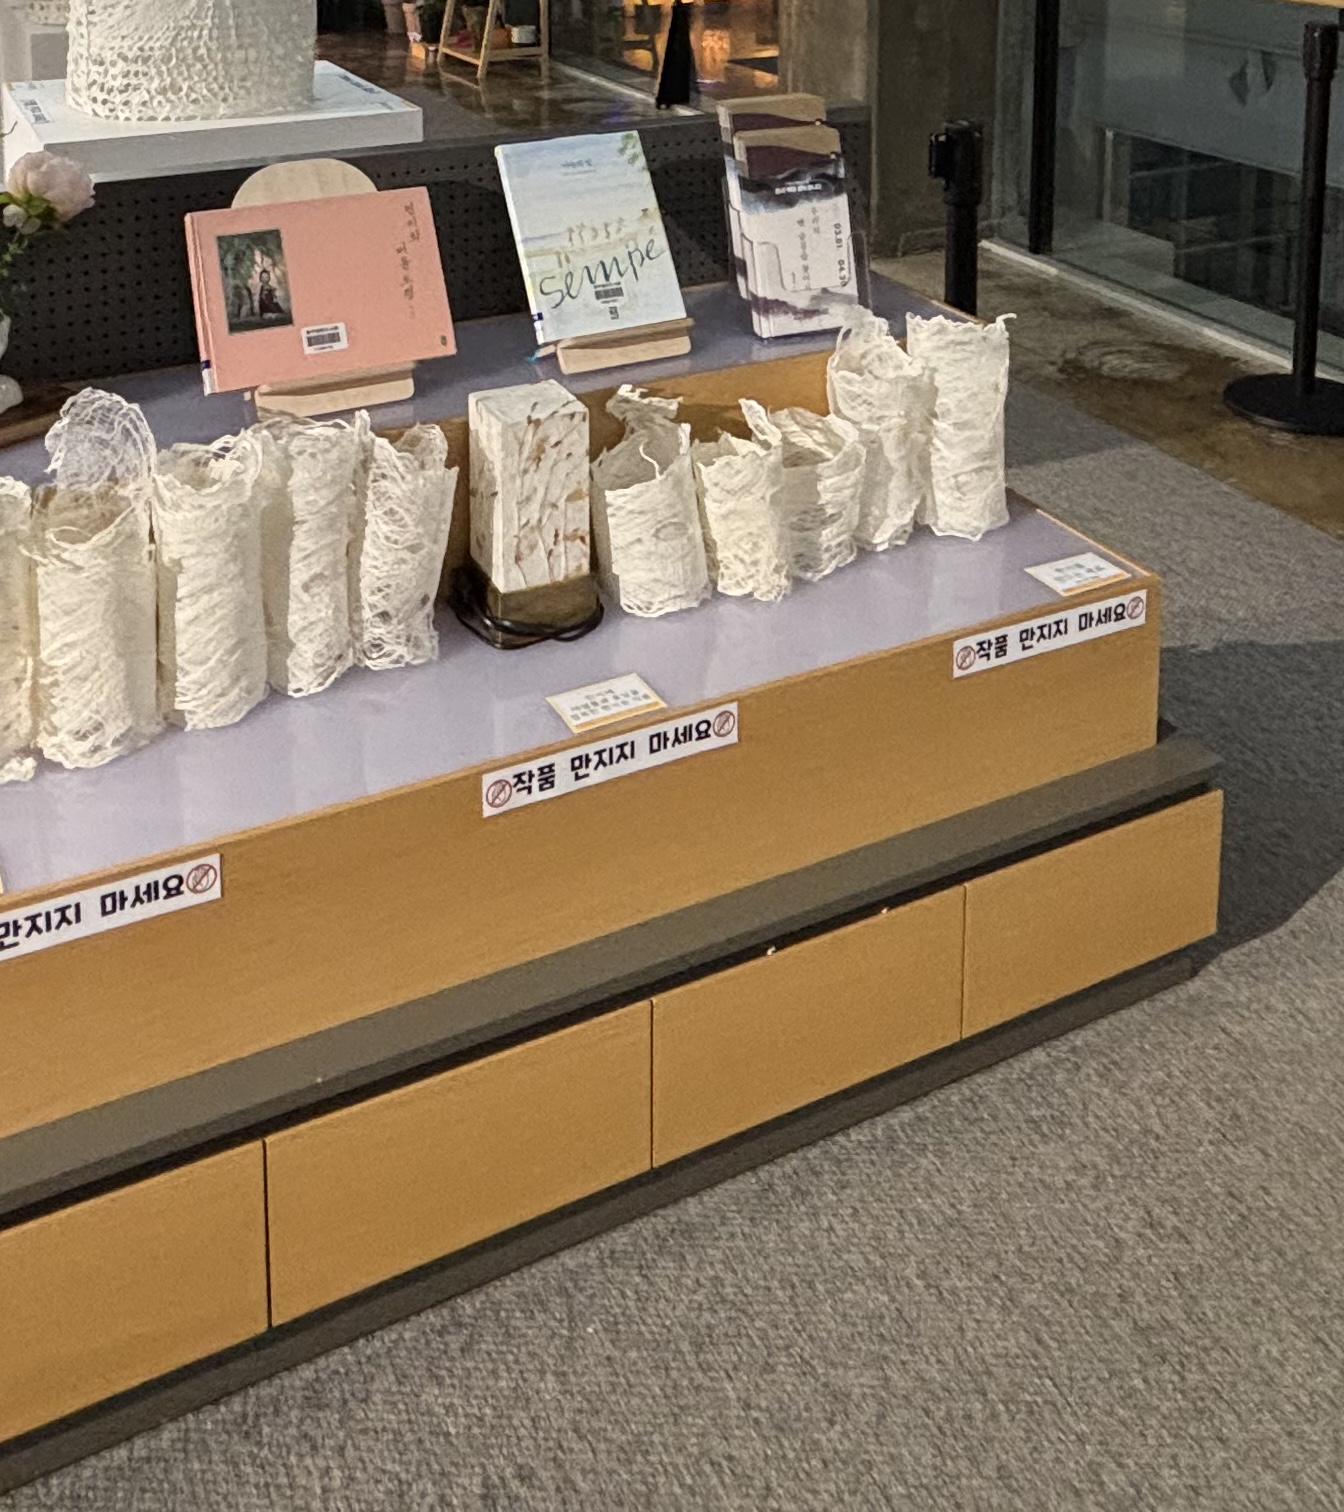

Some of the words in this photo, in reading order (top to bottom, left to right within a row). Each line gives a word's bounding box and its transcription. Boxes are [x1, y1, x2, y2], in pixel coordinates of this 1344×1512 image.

[975, 634, 1008, 662] 작품
[1019, 618, 1068, 651] 만지지
[1078, 602, 1126, 632] 마세요
[512, 762, 556, 796] 작품
[570, 740, 636, 781] 만지지
[649, 719, 713, 755] 마세요
[100, 873, 185, 918] 마세요
